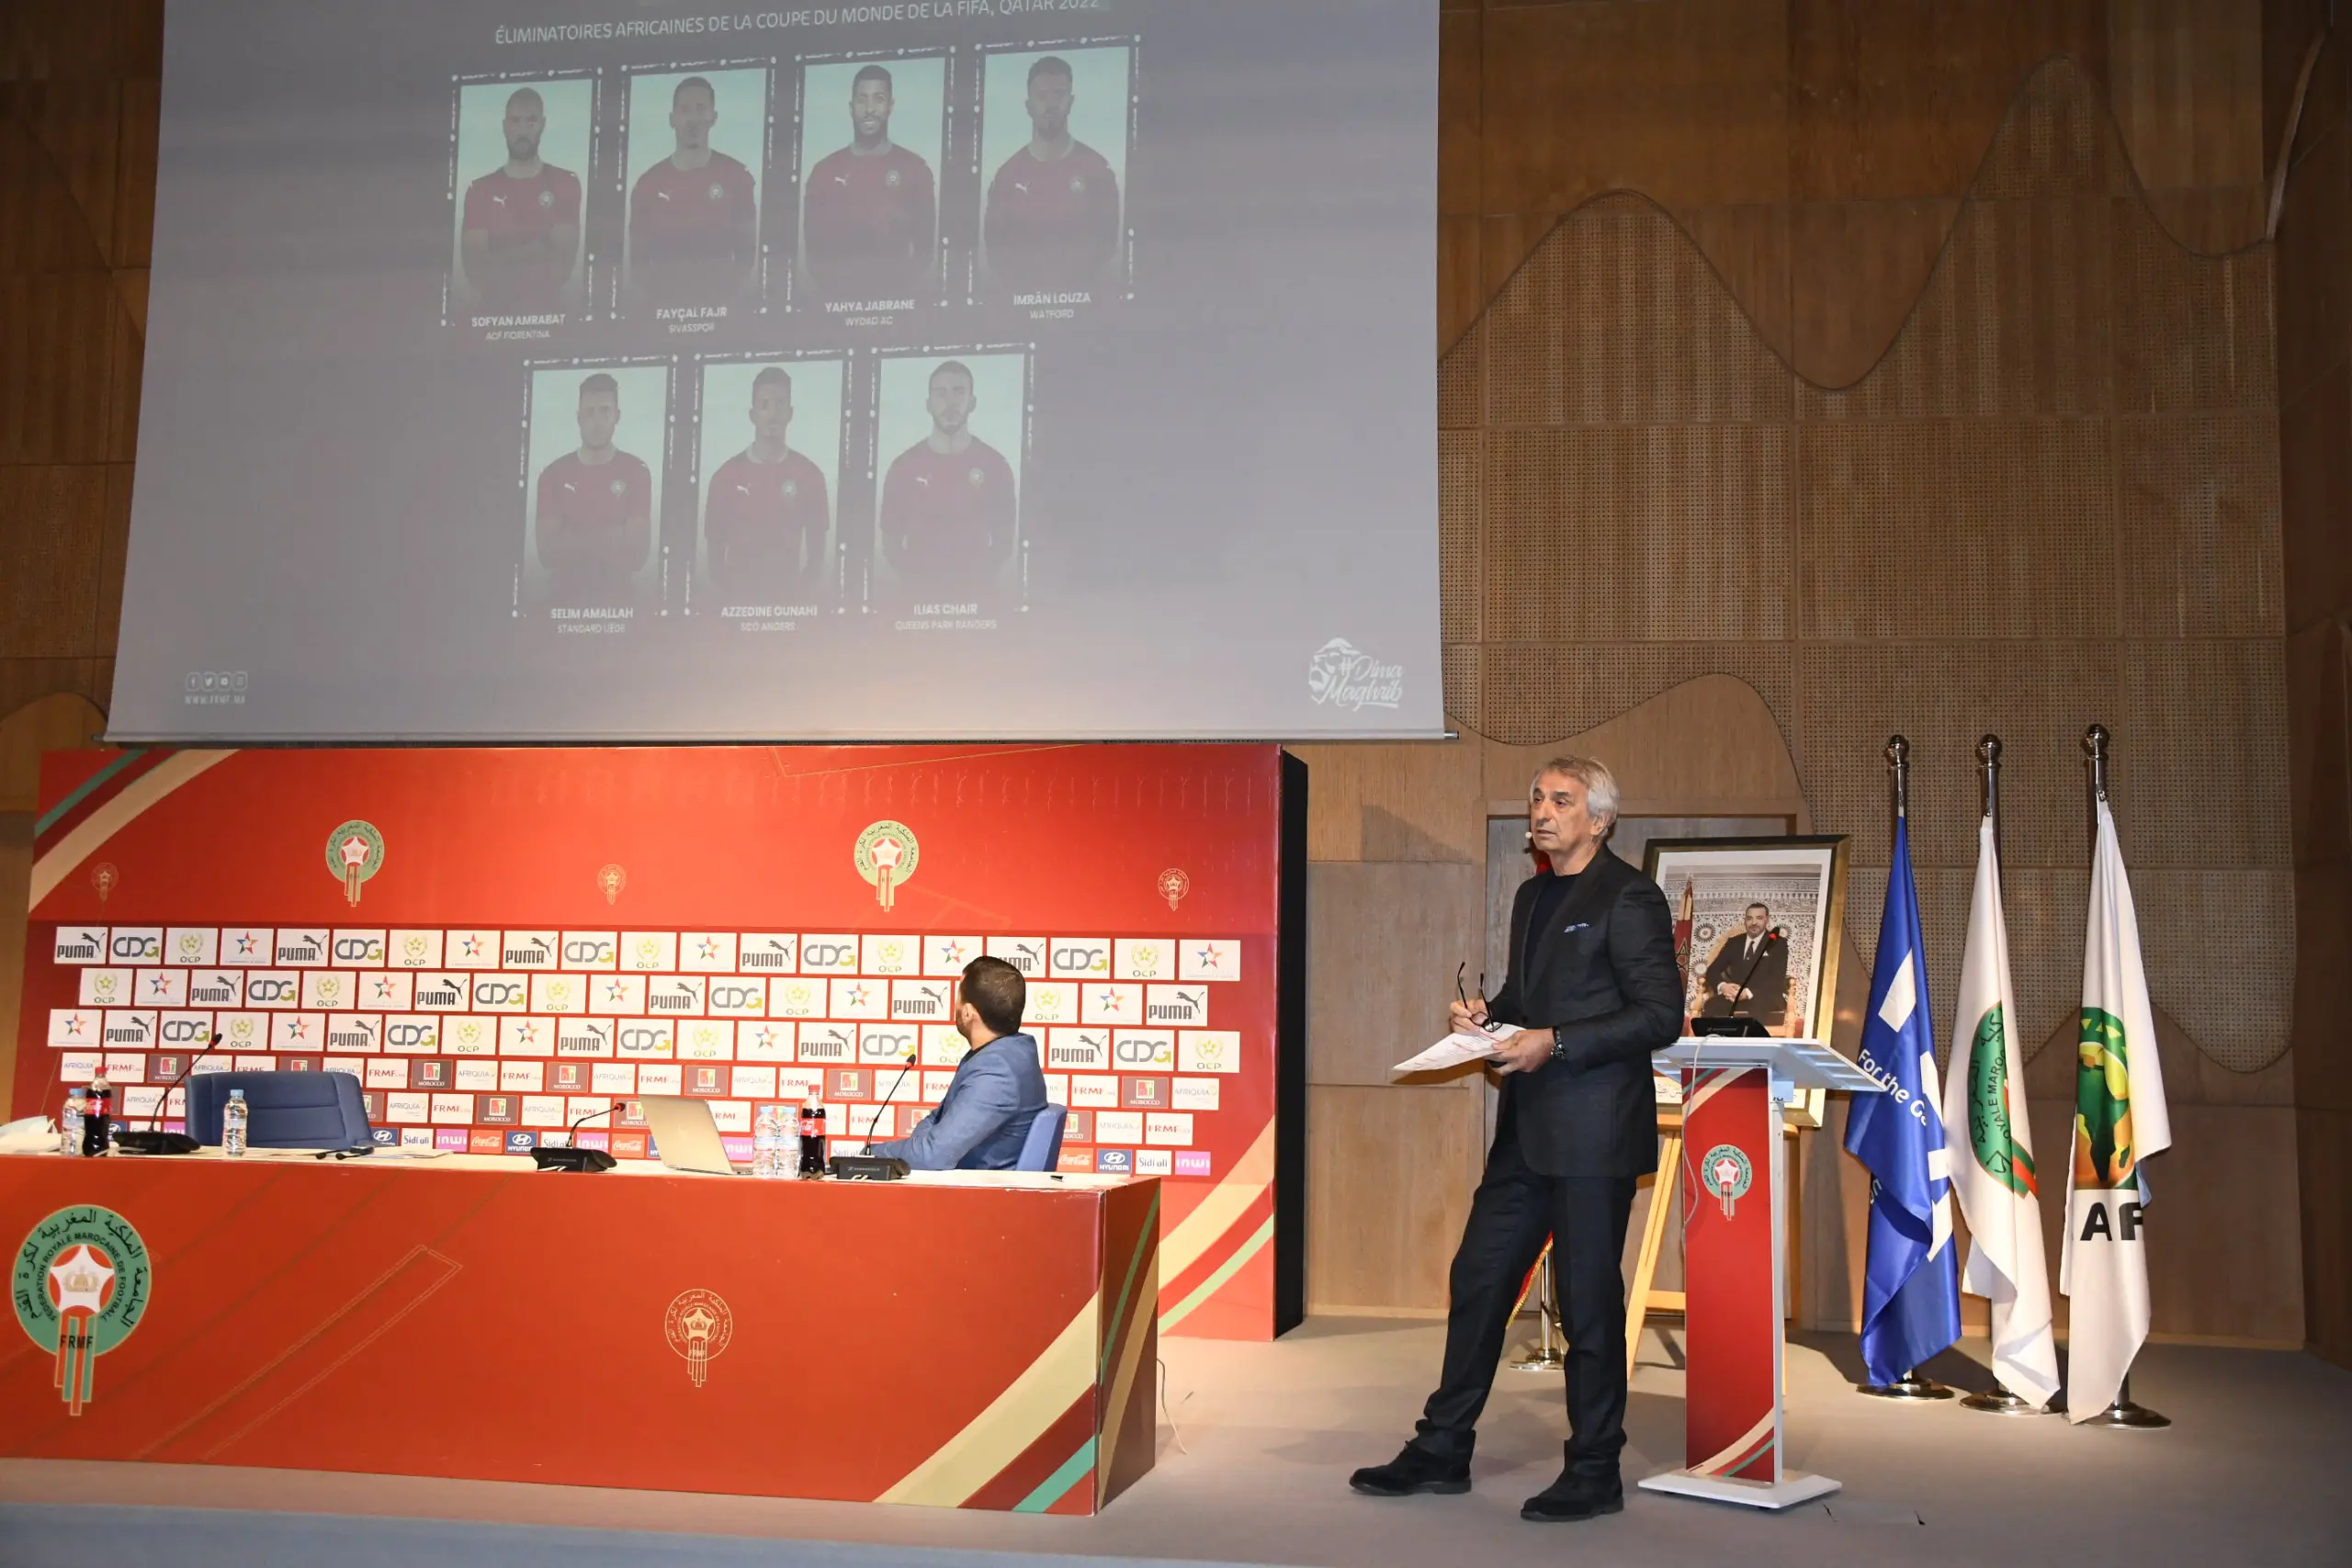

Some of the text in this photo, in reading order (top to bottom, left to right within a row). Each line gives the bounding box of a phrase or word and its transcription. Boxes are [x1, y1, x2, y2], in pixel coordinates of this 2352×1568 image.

[495, 23, 612, 44] ÉLIMINATOIRES
[616, 17, 705, 38] AFRICAINES
[708, 16, 729, 32] DE
[734, 14, 752, 30] LA
[756, 10, 809, 28] COUPE
[814, 8, 837, 26] DU
[842, 4, 904, 24] MONDE
[908, 3, 930, 19] DE
[933, 1, 954, 17] LA
[1000, 0, 1055, 14] QATAR
[1053, 291, 1091, 304] LOUZA
[656, 306, 728, 321] FAYÇAL FAJR
[825, 299, 915, 313] YAHYA JABRANE
[471, 313, 566, 327] SOFYAN AMRABAT
[550, 607, 634, 620] SELIM AMALLAH
[943, 604, 978, 615] CHAIR
[57, 944, 95, 958] PUMA
[112, 936, 160, 958] CDG
[277, 947, 316, 961] PUMA
[334, 939, 383, 960] CDG
[564, 942, 615, 963] CDG
[179, 955, 201, 964] OCP
[505, 950, 545, 964] PUMA
[741, 953, 784, 967] PUMA
[803, 944, 856, 967] CDG
[1053, 948, 1108, 971] CDG
[192, 988, 230, 1002] PUMA
[248, 980, 296, 1002] CDG
[417, 991, 456, 1005] PUMA
[475, 983, 525, 1005] CDG
[710, 987, 763, 1009] CDG
[650, 995, 691, 1010] PUMA
[893, 999, 935, 1014] PUMA
[1148, 1005, 1193, 1020] PUMA
[106, 1029, 143, 1043] PUMA
[162, 1021, 209, 1043] CDG
[330, 1032, 368, 1047] PUMA
[387, 1025, 436, 1046] CDG
[560, 1037, 600, 1051] PUMA
[620, 1029, 671, 1051] CDG
[862, 1034, 915, 1056] CDG
[800, 1043, 842, 1056] PUMA
[1051, 1048, 1095, 1063] PUMA
[1116, 1040, 1171, 1063] CDG
[1197, 1062, 1222, 1070] OCP
[1881, 1072, 1910, 1104] the
[715, 1112, 736, 1121] RMF
[403, 1134, 418, 1145] Sidi
[436, 1135, 467, 1145] inwi
[1138, 1157, 1155, 1168] Sidi
[1176, 1157, 1210, 1168] inwi
[60, 1334, 94, 1349] FRMF
